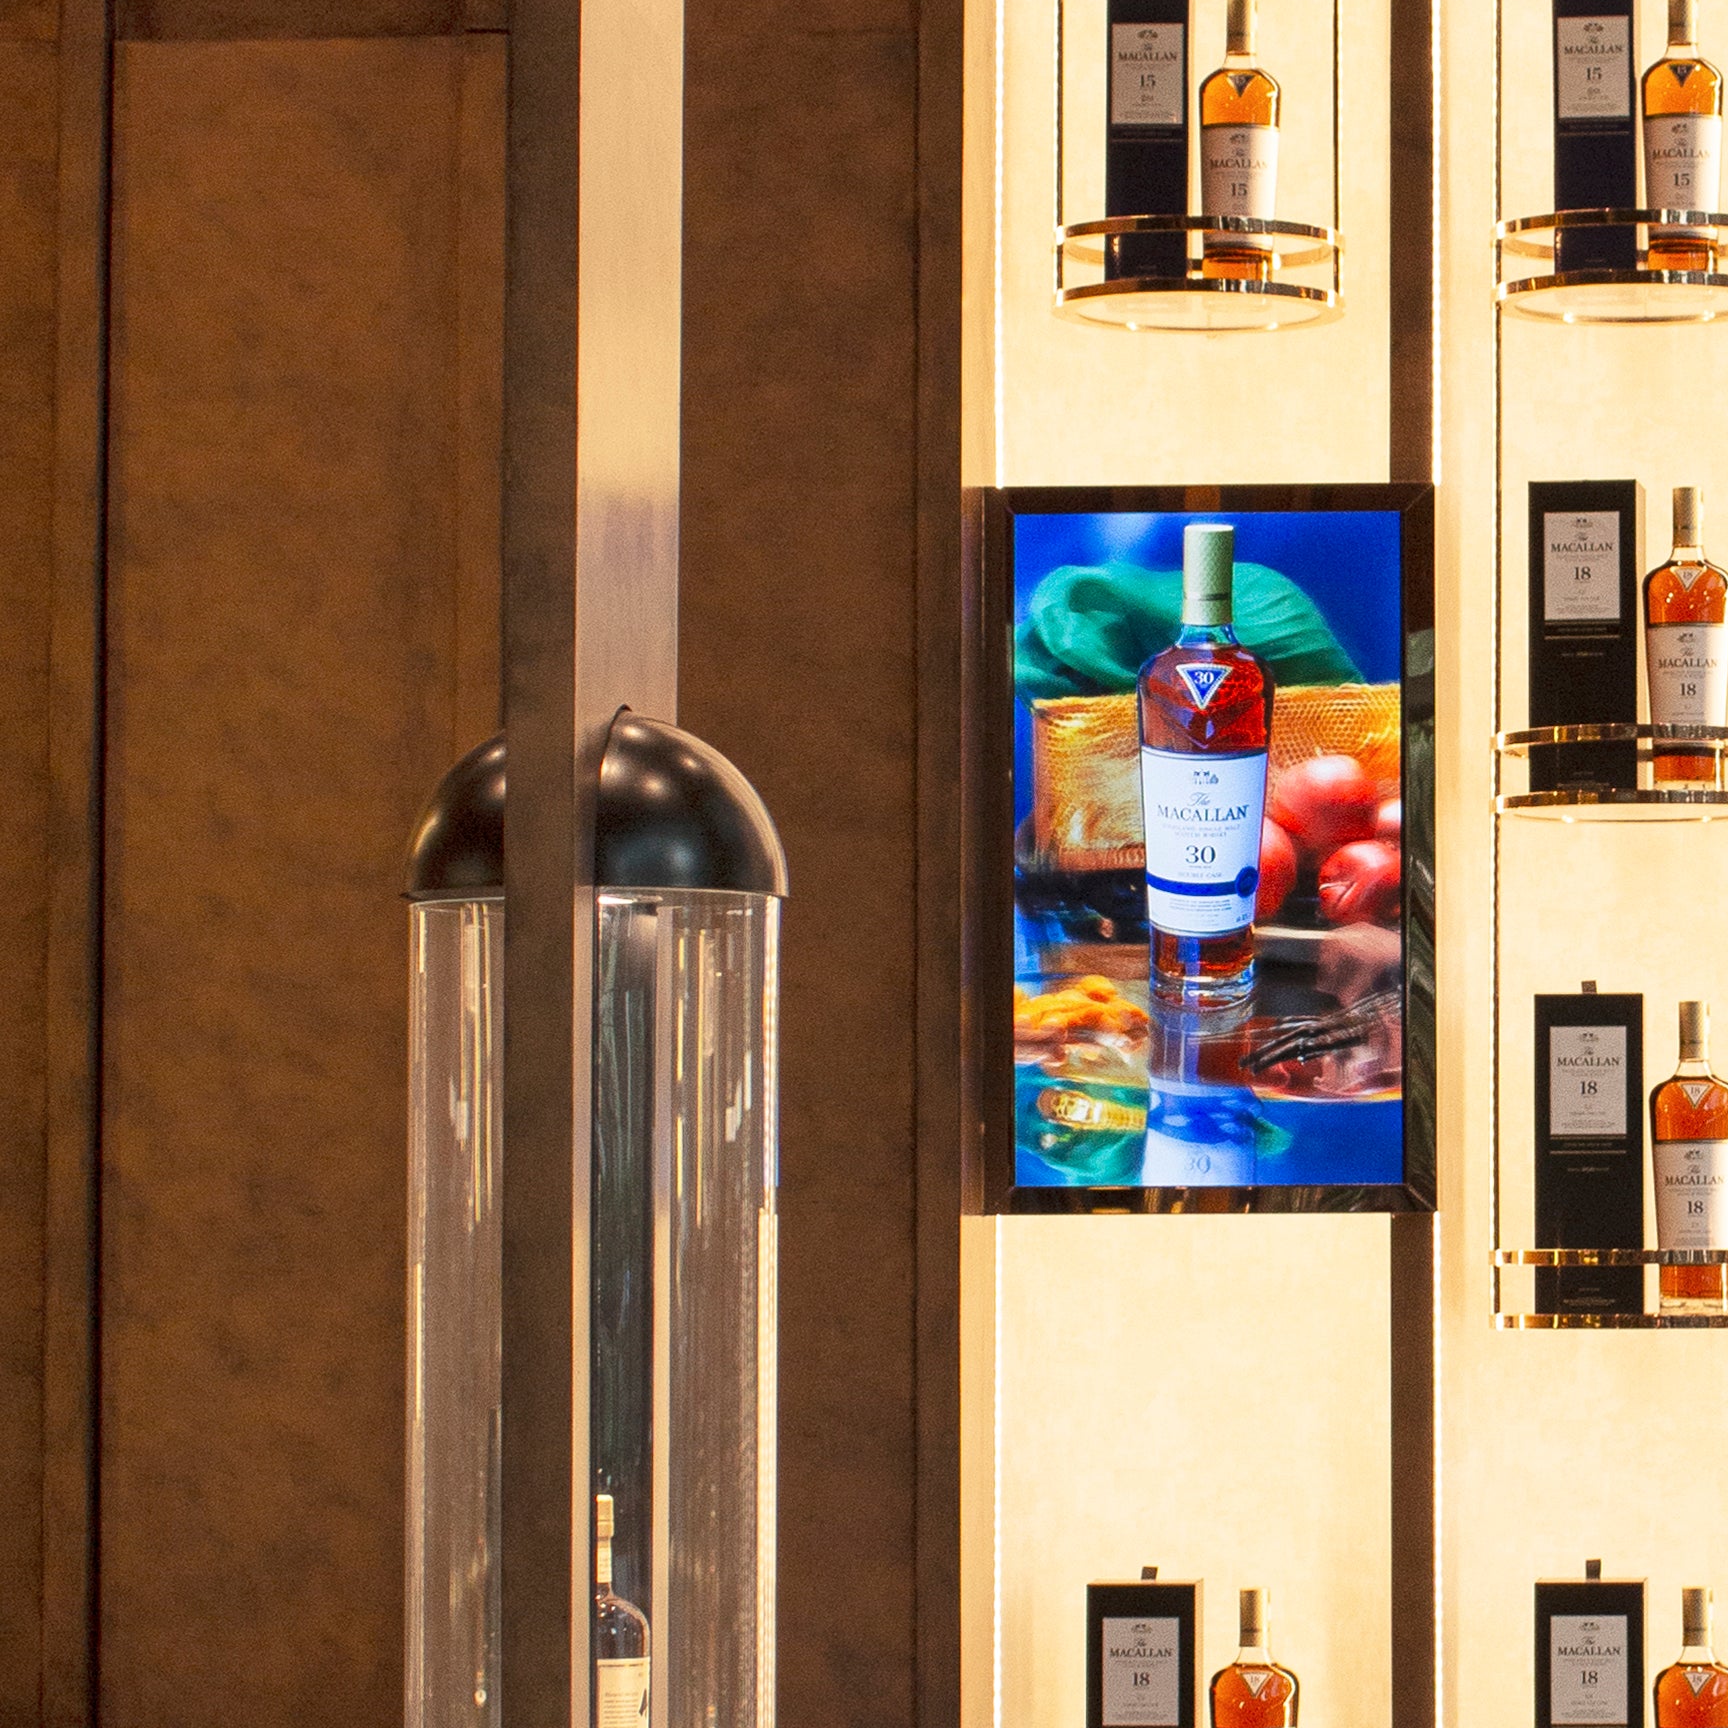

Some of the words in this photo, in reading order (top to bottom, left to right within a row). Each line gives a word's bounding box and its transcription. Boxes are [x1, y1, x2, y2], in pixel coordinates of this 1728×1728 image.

[1564, 44, 1624, 55] MACALLAN
[1118, 51, 1178, 62] MACALLAN
[1586, 67, 1602, 80] 15
[1140, 74, 1156, 88] 15
[1673, 173, 1690, 187] 15
[1231, 183, 1248, 197] 15
[1551, 541, 1613, 553] MACALLAN
[1574, 566, 1591, 580] 18
[1658, 657, 1718, 669] MACALLAN
[1194, 672, 1214, 685] 30
[1680, 683, 1696, 696] 18
[1188, 792, 1210, 806] The
[1158, 804, 1249, 822] MACALLAN
[1185, 845, 1216, 864] 30
[1557, 1056, 1621, 1067] MACALLAN
[1580, 1080, 1598, 1095] 18
[1664, 1174, 1726, 1186] MACALLAN
[1687, 1200, 1703, 1214] 18
[1109, 1647, 1173, 1659] MACALLAN
[1557, 1646, 1621, 1657] MACALLAN
[1132, 1672, 1149, 1686] 18
[1580, 1670, 1598, 1685] 18
